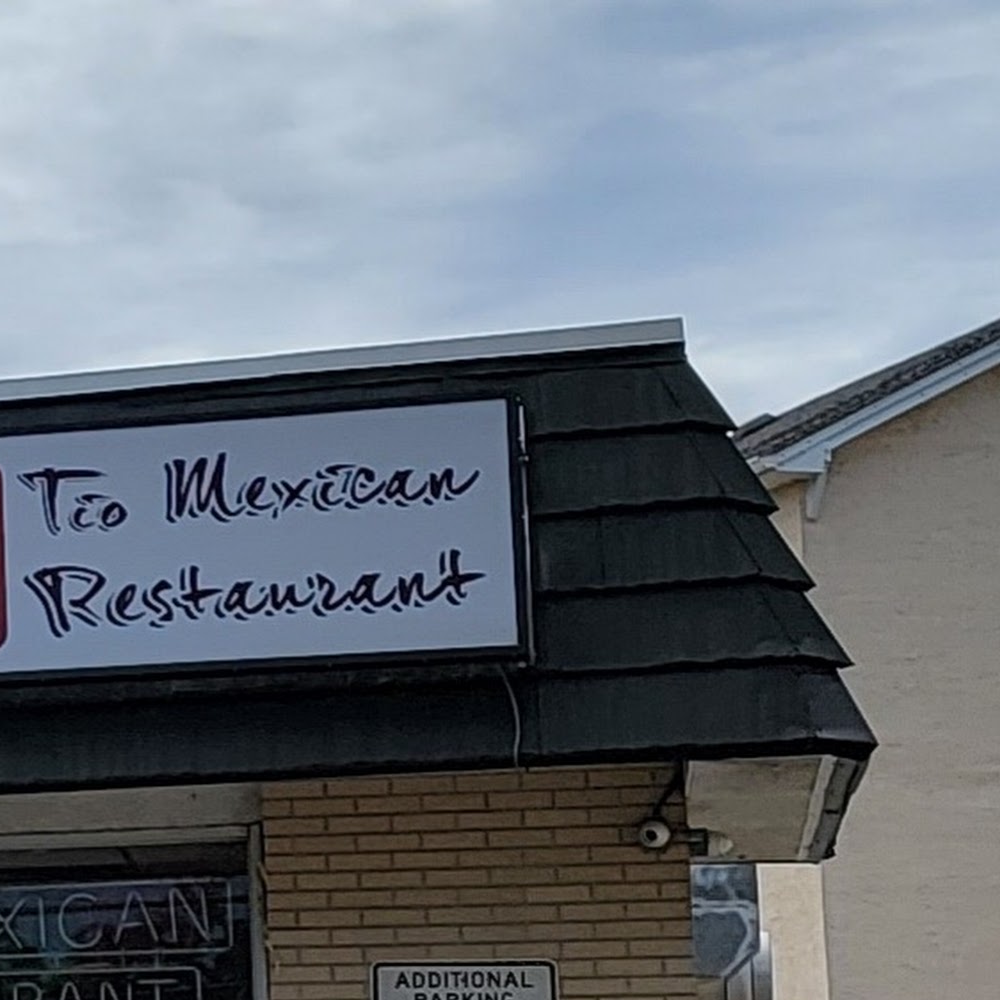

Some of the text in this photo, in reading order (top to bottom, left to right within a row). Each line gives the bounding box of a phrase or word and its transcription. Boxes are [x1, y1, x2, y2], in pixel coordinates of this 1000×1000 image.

[17, 452, 481, 536] Tio Mexican
[24, 549, 487, 638] Restaurant
[395, 971, 535, 989] ADDITIONAL
